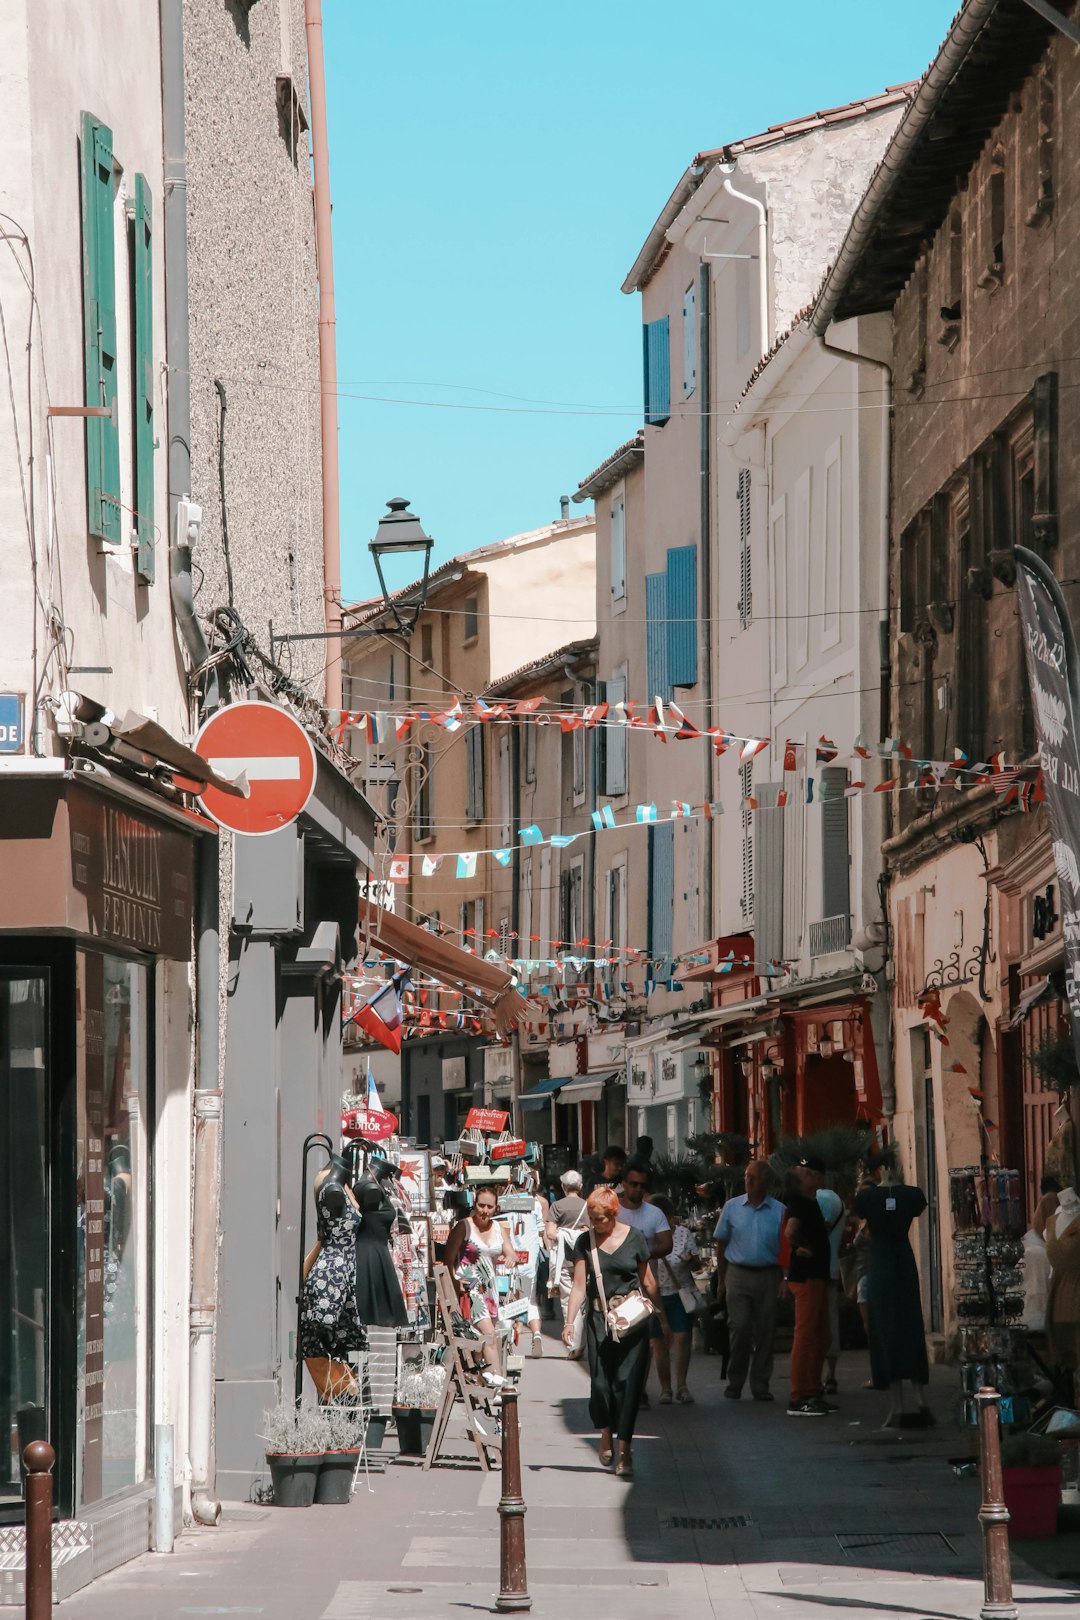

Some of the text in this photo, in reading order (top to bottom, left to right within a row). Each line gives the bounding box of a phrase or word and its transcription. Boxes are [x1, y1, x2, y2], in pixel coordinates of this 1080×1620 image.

[102, 804, 161, 903] MASCULIN
[102, 892, 161, 948] FEMININ
[349, 1119, 381, 1131] EDITOR
